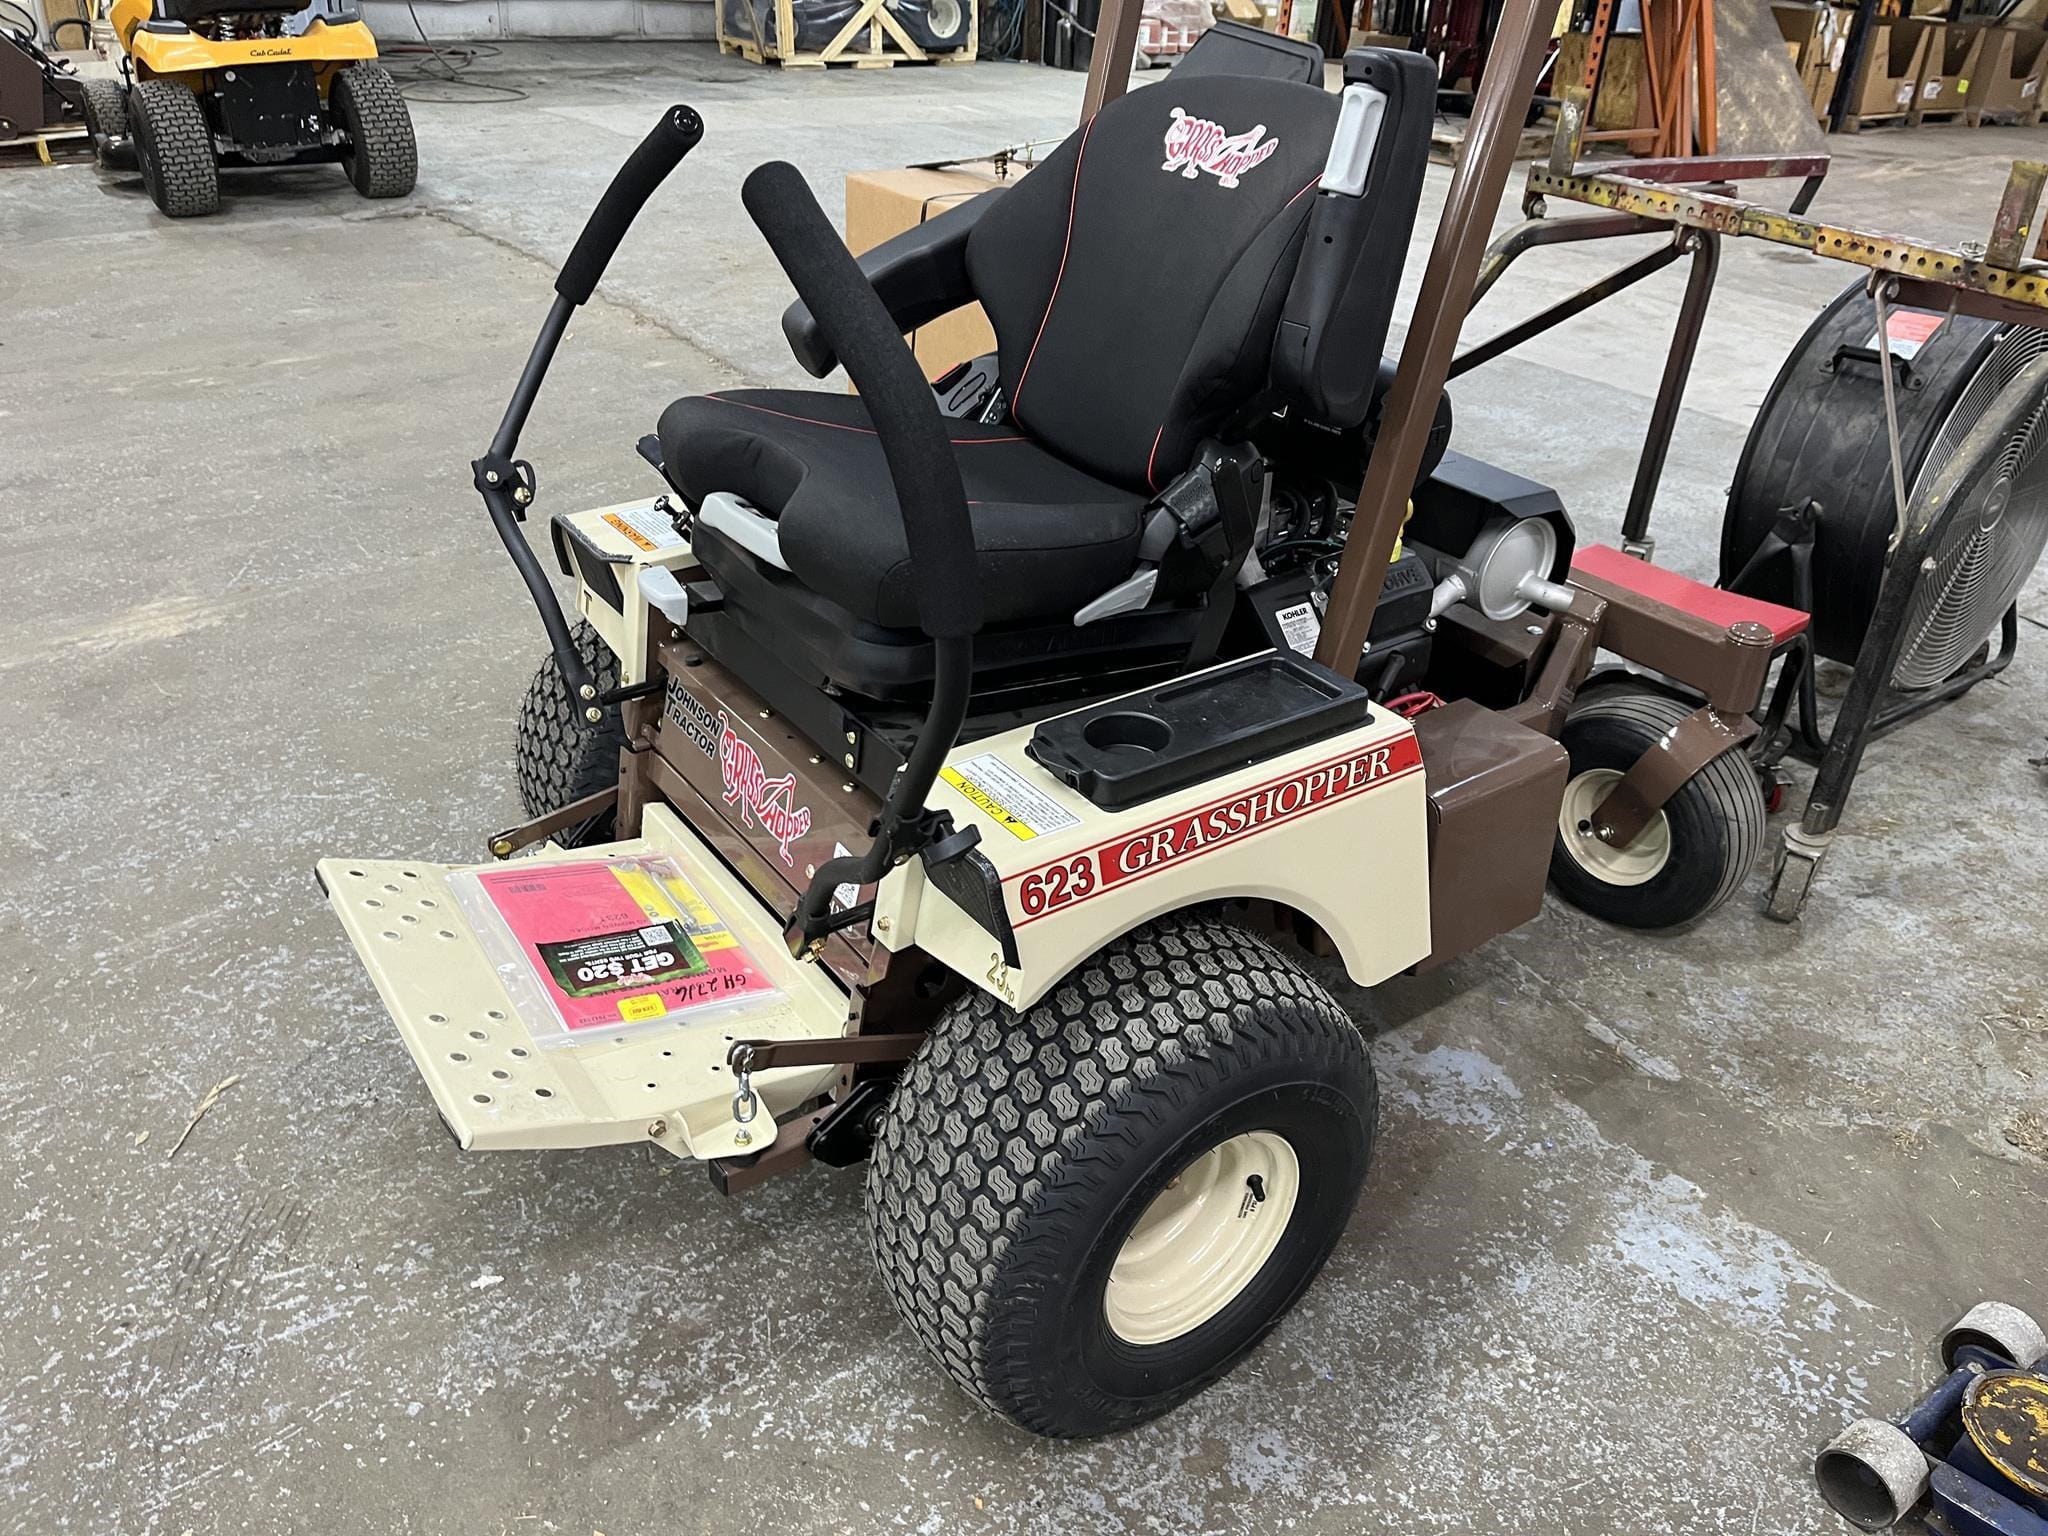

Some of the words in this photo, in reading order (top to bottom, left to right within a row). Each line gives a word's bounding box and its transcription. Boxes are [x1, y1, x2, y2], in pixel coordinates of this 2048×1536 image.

[250, 49, 266, 57] Cub
[266, 48, 292, 57] Cadet
[1282, 607, 1309, 620] KOHLER
[668, 675, 721, 737] JOHNSON
[665, 696, 717, 760] TRACTOR
[957, 781, 1003, 816] CAUTION
[1118, 747, 1391, 874] GRASSHOPPER
[1020, 856, 1096, 916] 623
[577, 961, 625, 982] $20
[631, 952, 675, 974] GET
[986, 952, 1009, 992] 23
[1005, 983, 1015, 1003] hp
[723, 974, 746, 989] GH
